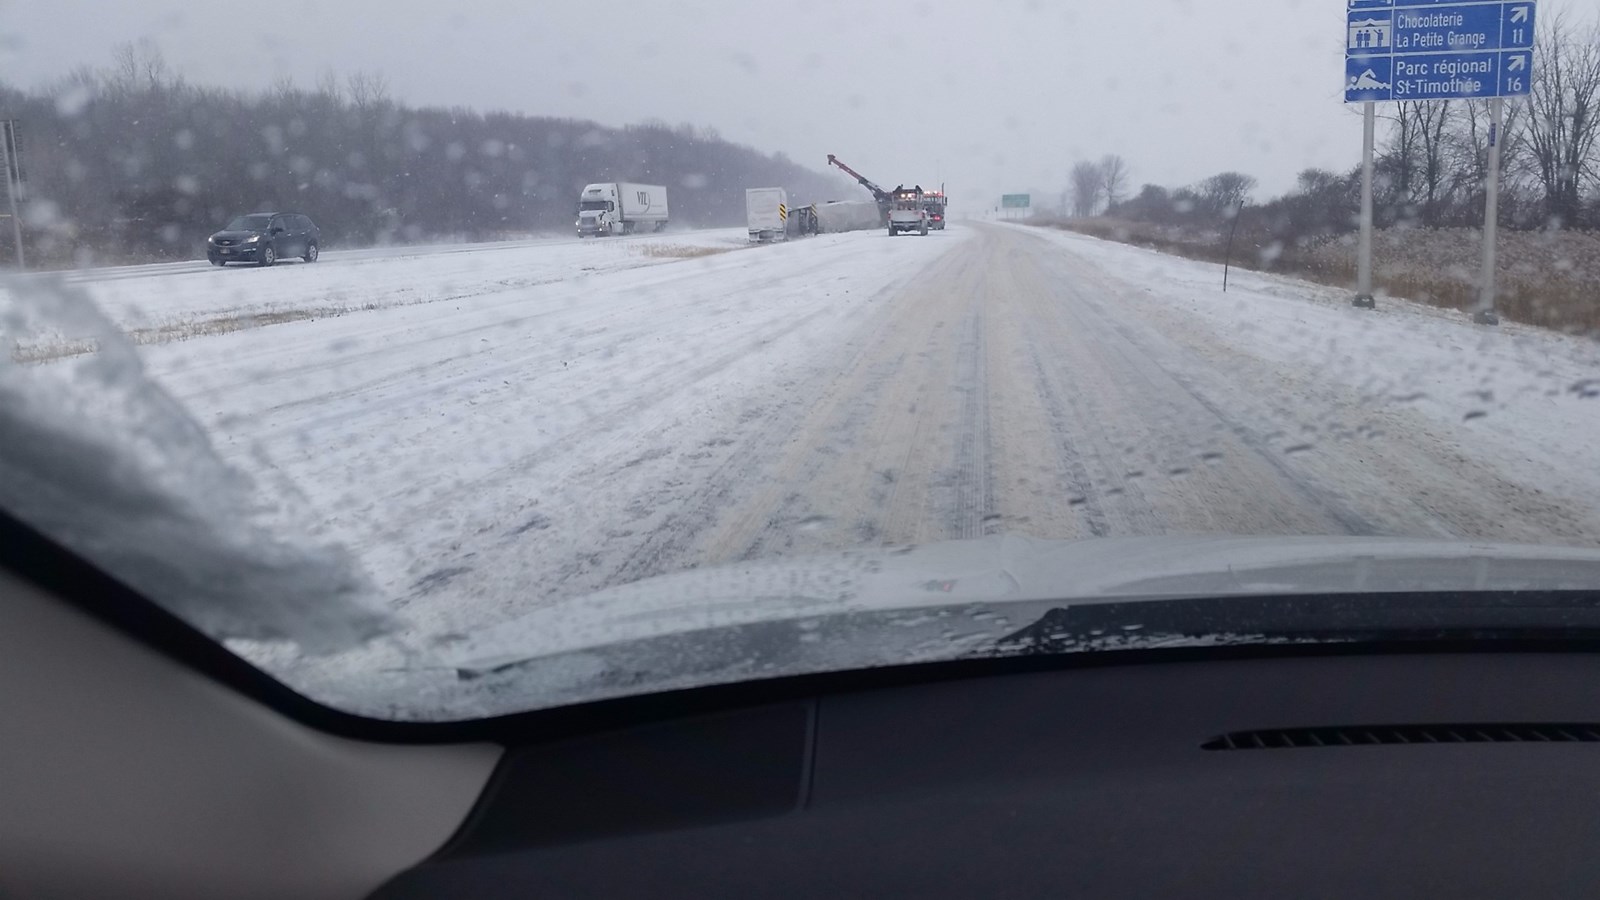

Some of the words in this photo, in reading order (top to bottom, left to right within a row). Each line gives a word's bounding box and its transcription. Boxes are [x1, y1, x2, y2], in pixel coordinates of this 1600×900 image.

[1398, 12, 1463, 29] Chocolaterie
[1396, 34, 1409, 48] La
[1412, 32, 1443, 47] Petite
[1447, 31, 1486, 48] Grange
[1512, 29, 1523, 44] 11
[1396, 61, 1428, 76] Parc
[1433, 58, 1492, 78] régional
[1396, 78, 1482, 95] St-Timothée
[1507, 77, 1522, 92] 16
